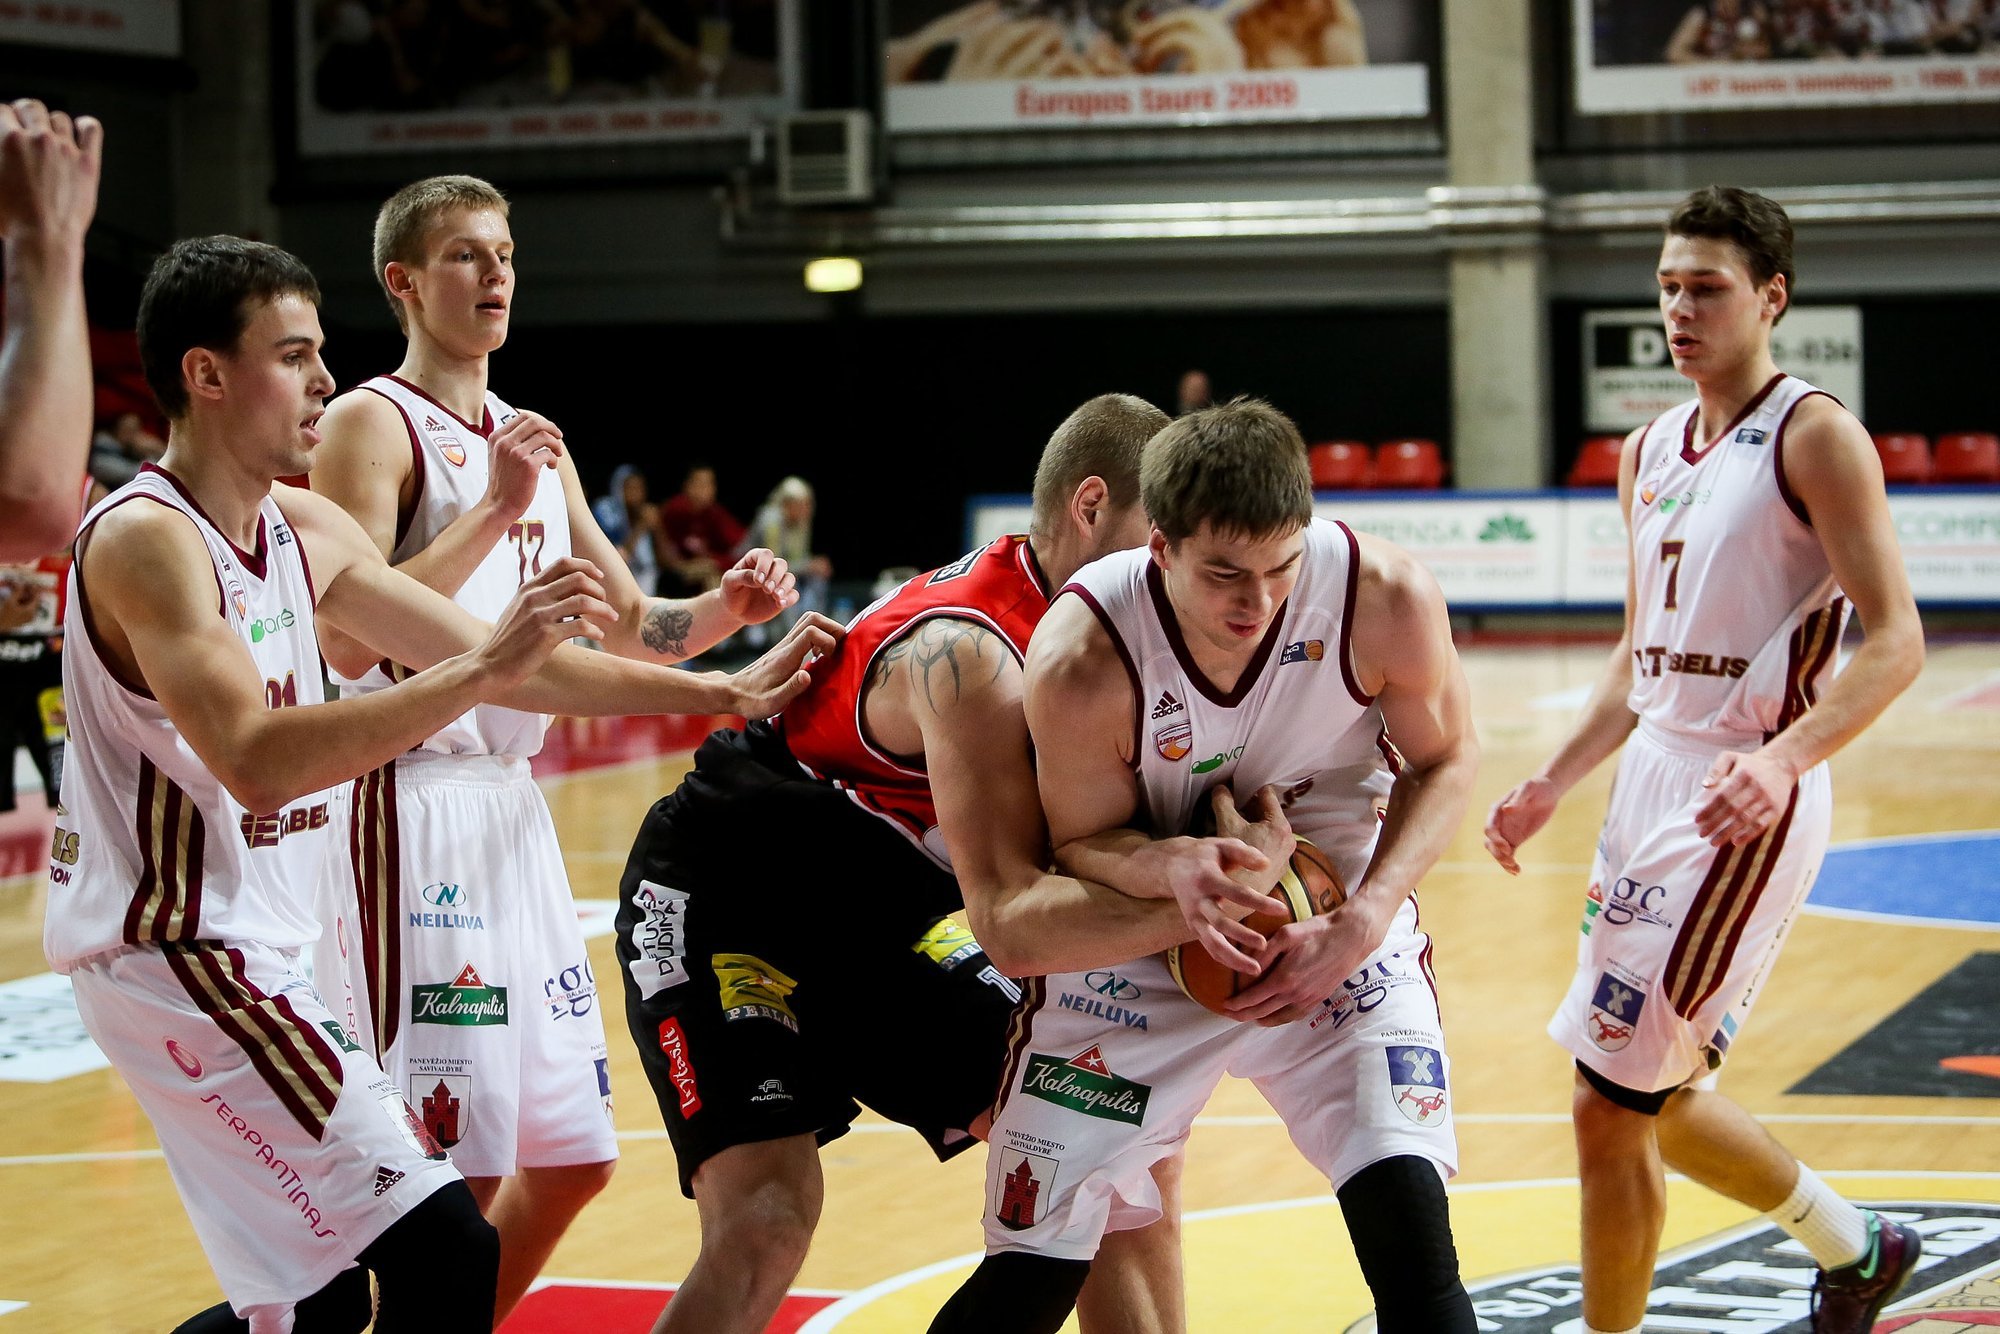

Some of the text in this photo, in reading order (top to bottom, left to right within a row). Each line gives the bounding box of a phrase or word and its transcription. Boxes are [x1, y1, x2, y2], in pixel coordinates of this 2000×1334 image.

[1660, 539, 1686, 613] 7
[1151, 703, 1184, 720] adidas
[410, 912, 485, 931] NEILUVA
[415, 991, 506, 1023] Kalnapilis
[1058, 992, 1148, 1032] NEILUVA
[1024, 1062, 1142, 1115] Kalnapilis
[200, 1093, 338, 1239] SERPANTINAS
[374, 1171, 406, 1197] adidas
